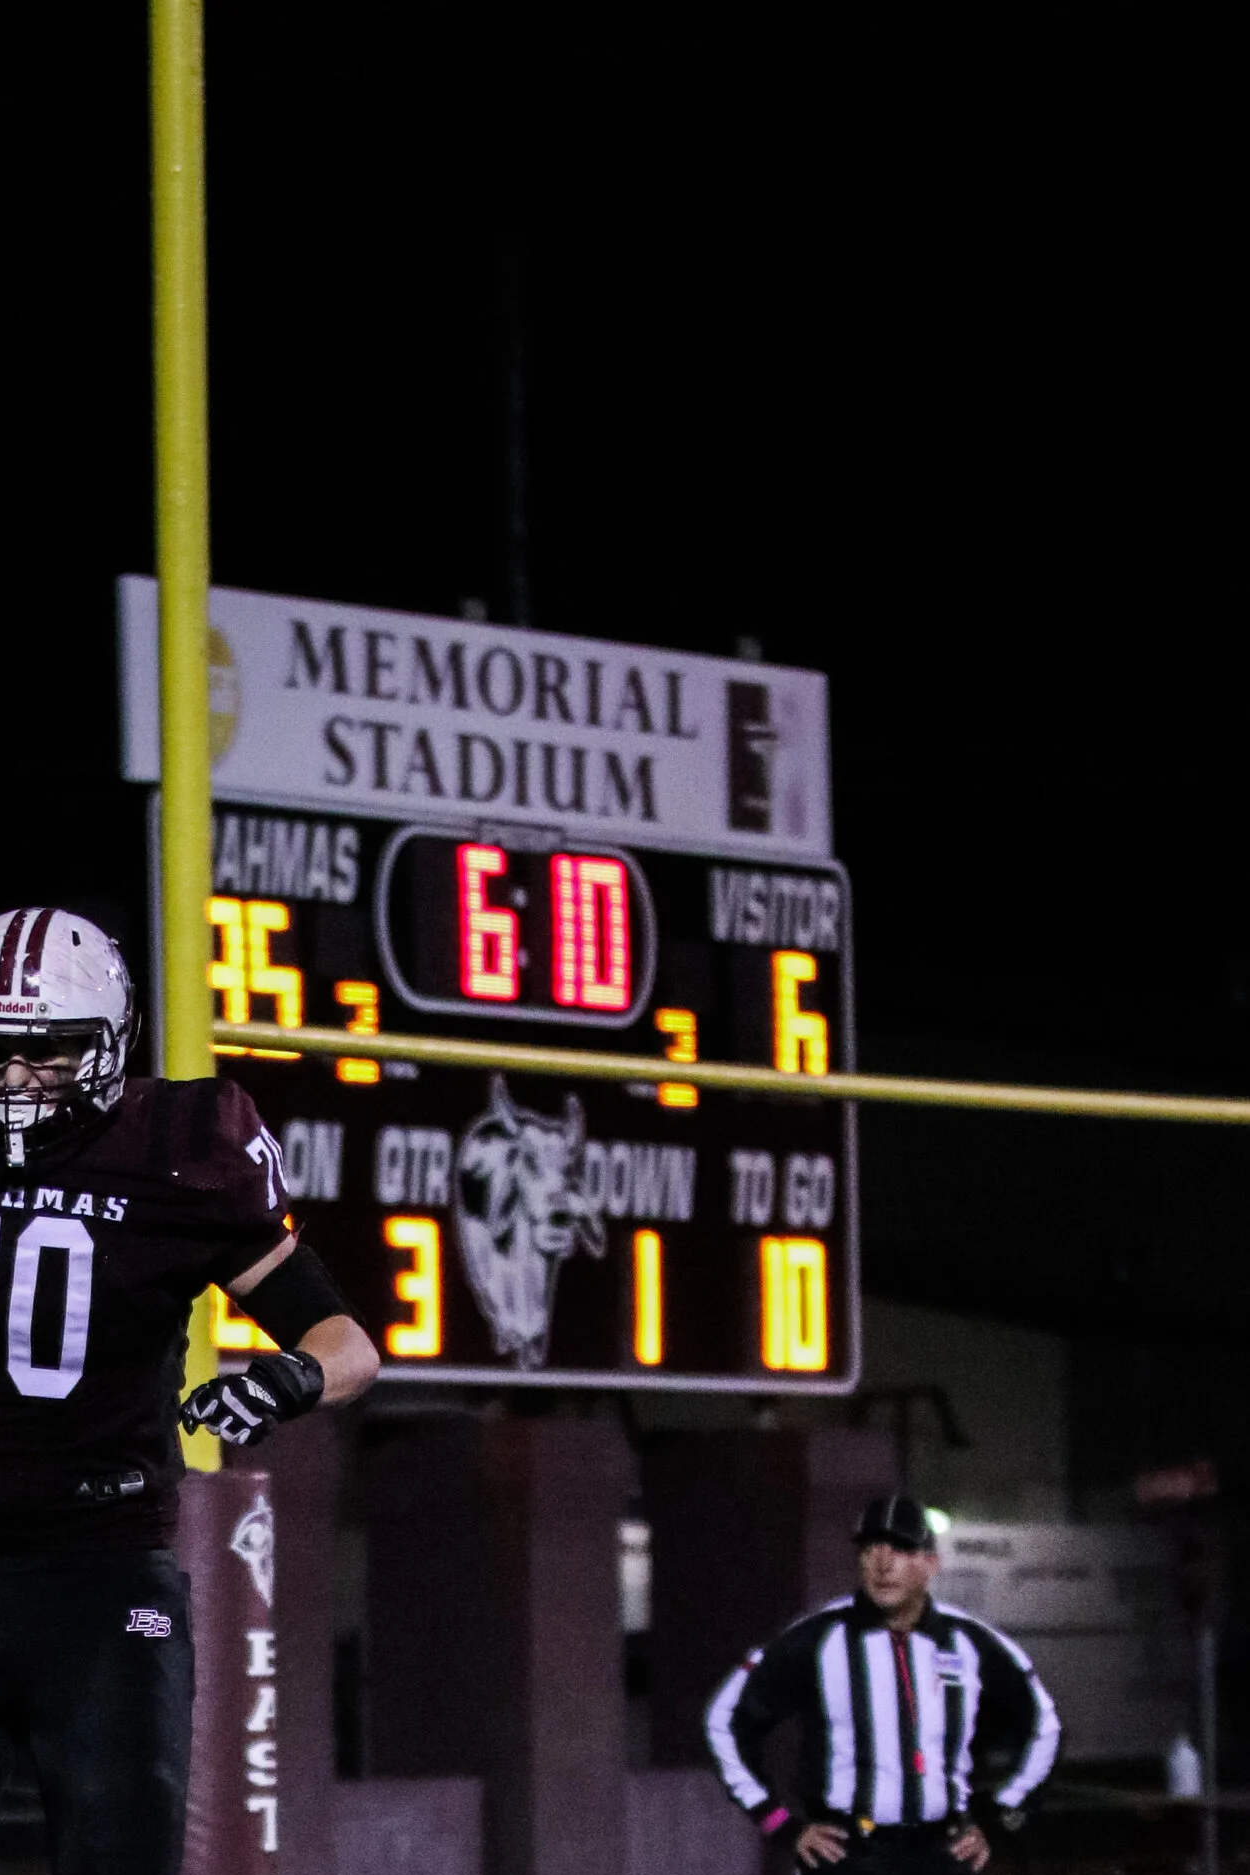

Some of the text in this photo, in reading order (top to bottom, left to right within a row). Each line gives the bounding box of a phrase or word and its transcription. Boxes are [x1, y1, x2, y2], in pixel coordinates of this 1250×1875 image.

[285, 619, 699, 740] MEMORIAL
[323, 714, 659, 823] STADIUM
[210, 814, 360, 904] AHMAS
[709, 868, 840, 951] VISITOR
[375, 1123, 453, 1207] QTR
[582, 1140, 696, 1222] DOWN
[730, 1150, 836, 1230] TO GO
[382, 1214, 442, 1358] 3
[632, 1226, 662, 1367] 1
[759, 1233, 828, 1372] 10
[126, 1609, 171, 1637] EB
